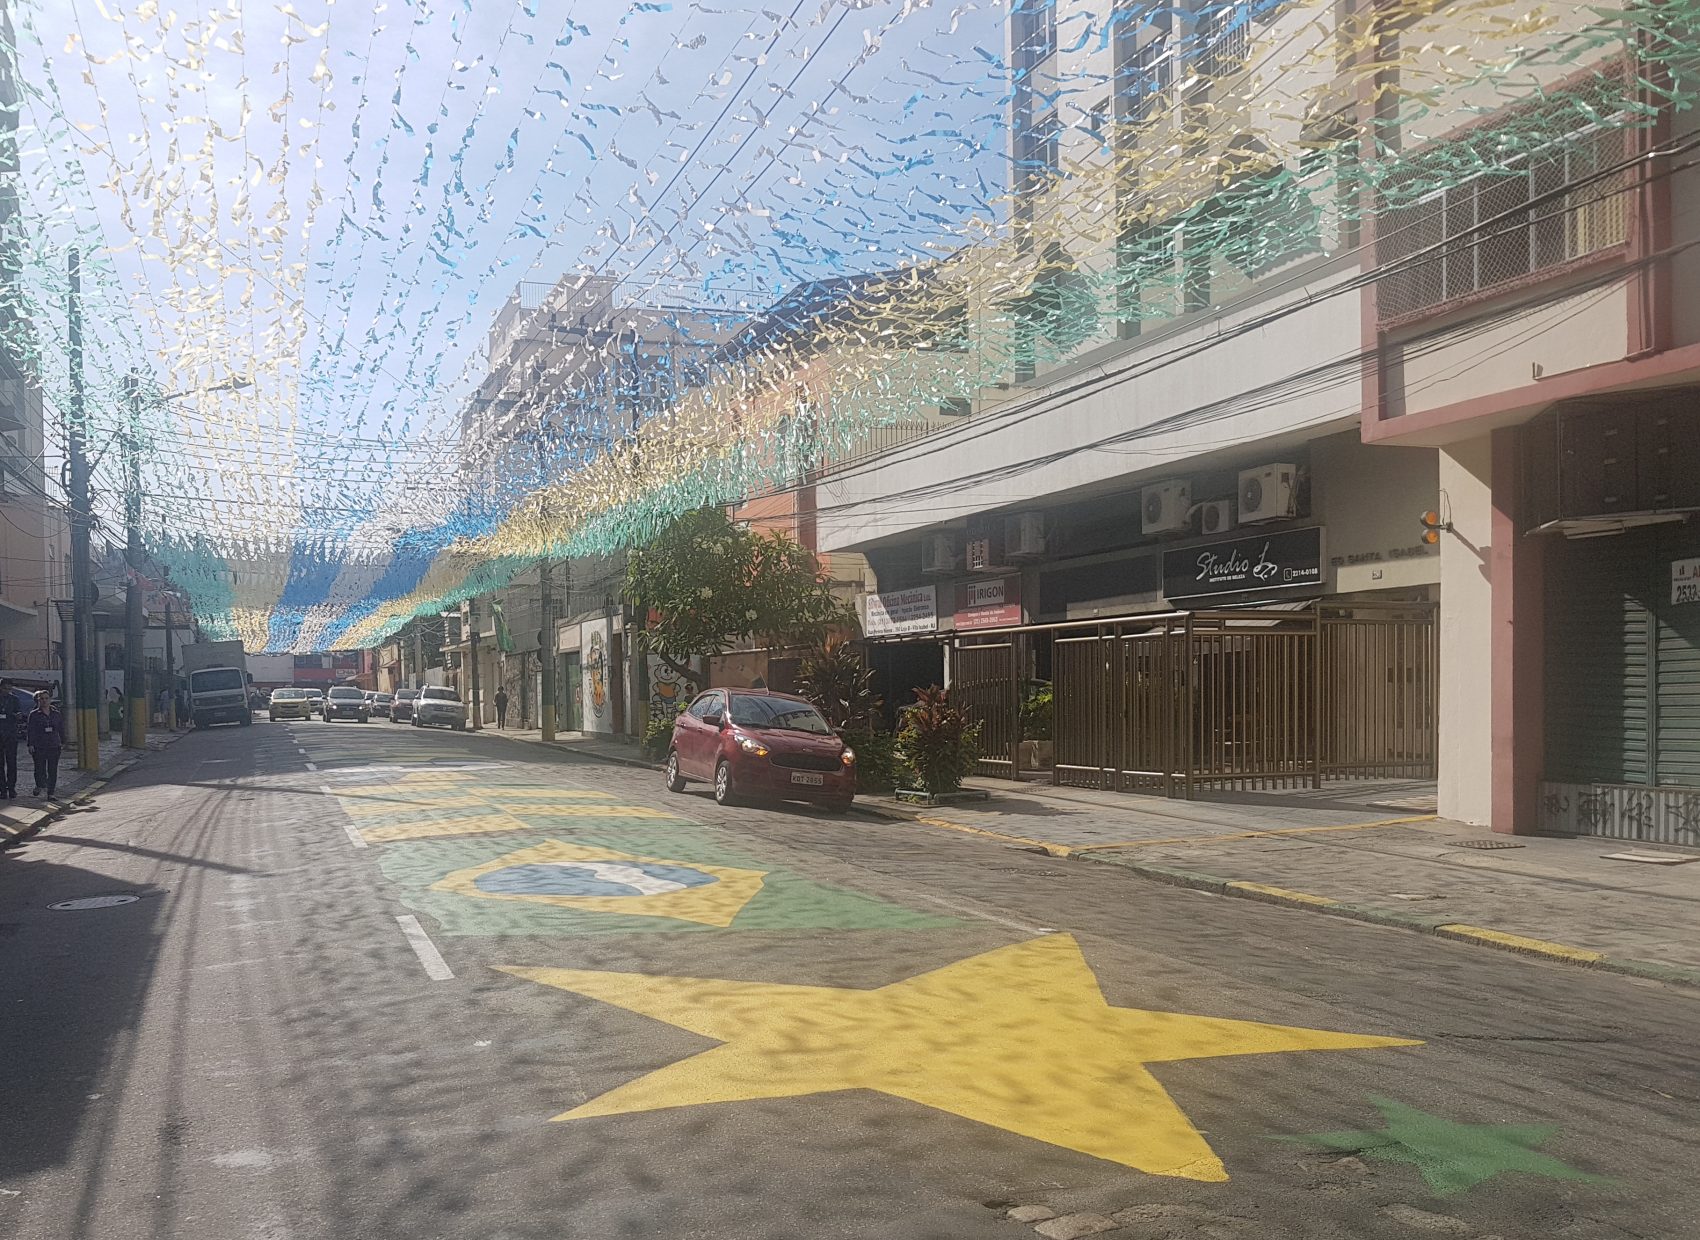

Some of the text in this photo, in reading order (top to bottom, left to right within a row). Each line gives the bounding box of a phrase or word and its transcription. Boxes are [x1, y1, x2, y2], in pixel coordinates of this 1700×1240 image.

[1196, 549, 1249, 580] Studio
[1347, 551, 1383, 565] SANTA
[1388, 545, 1429, 559] ISABEL
[977, 585, 1004, 599] IRIGON
